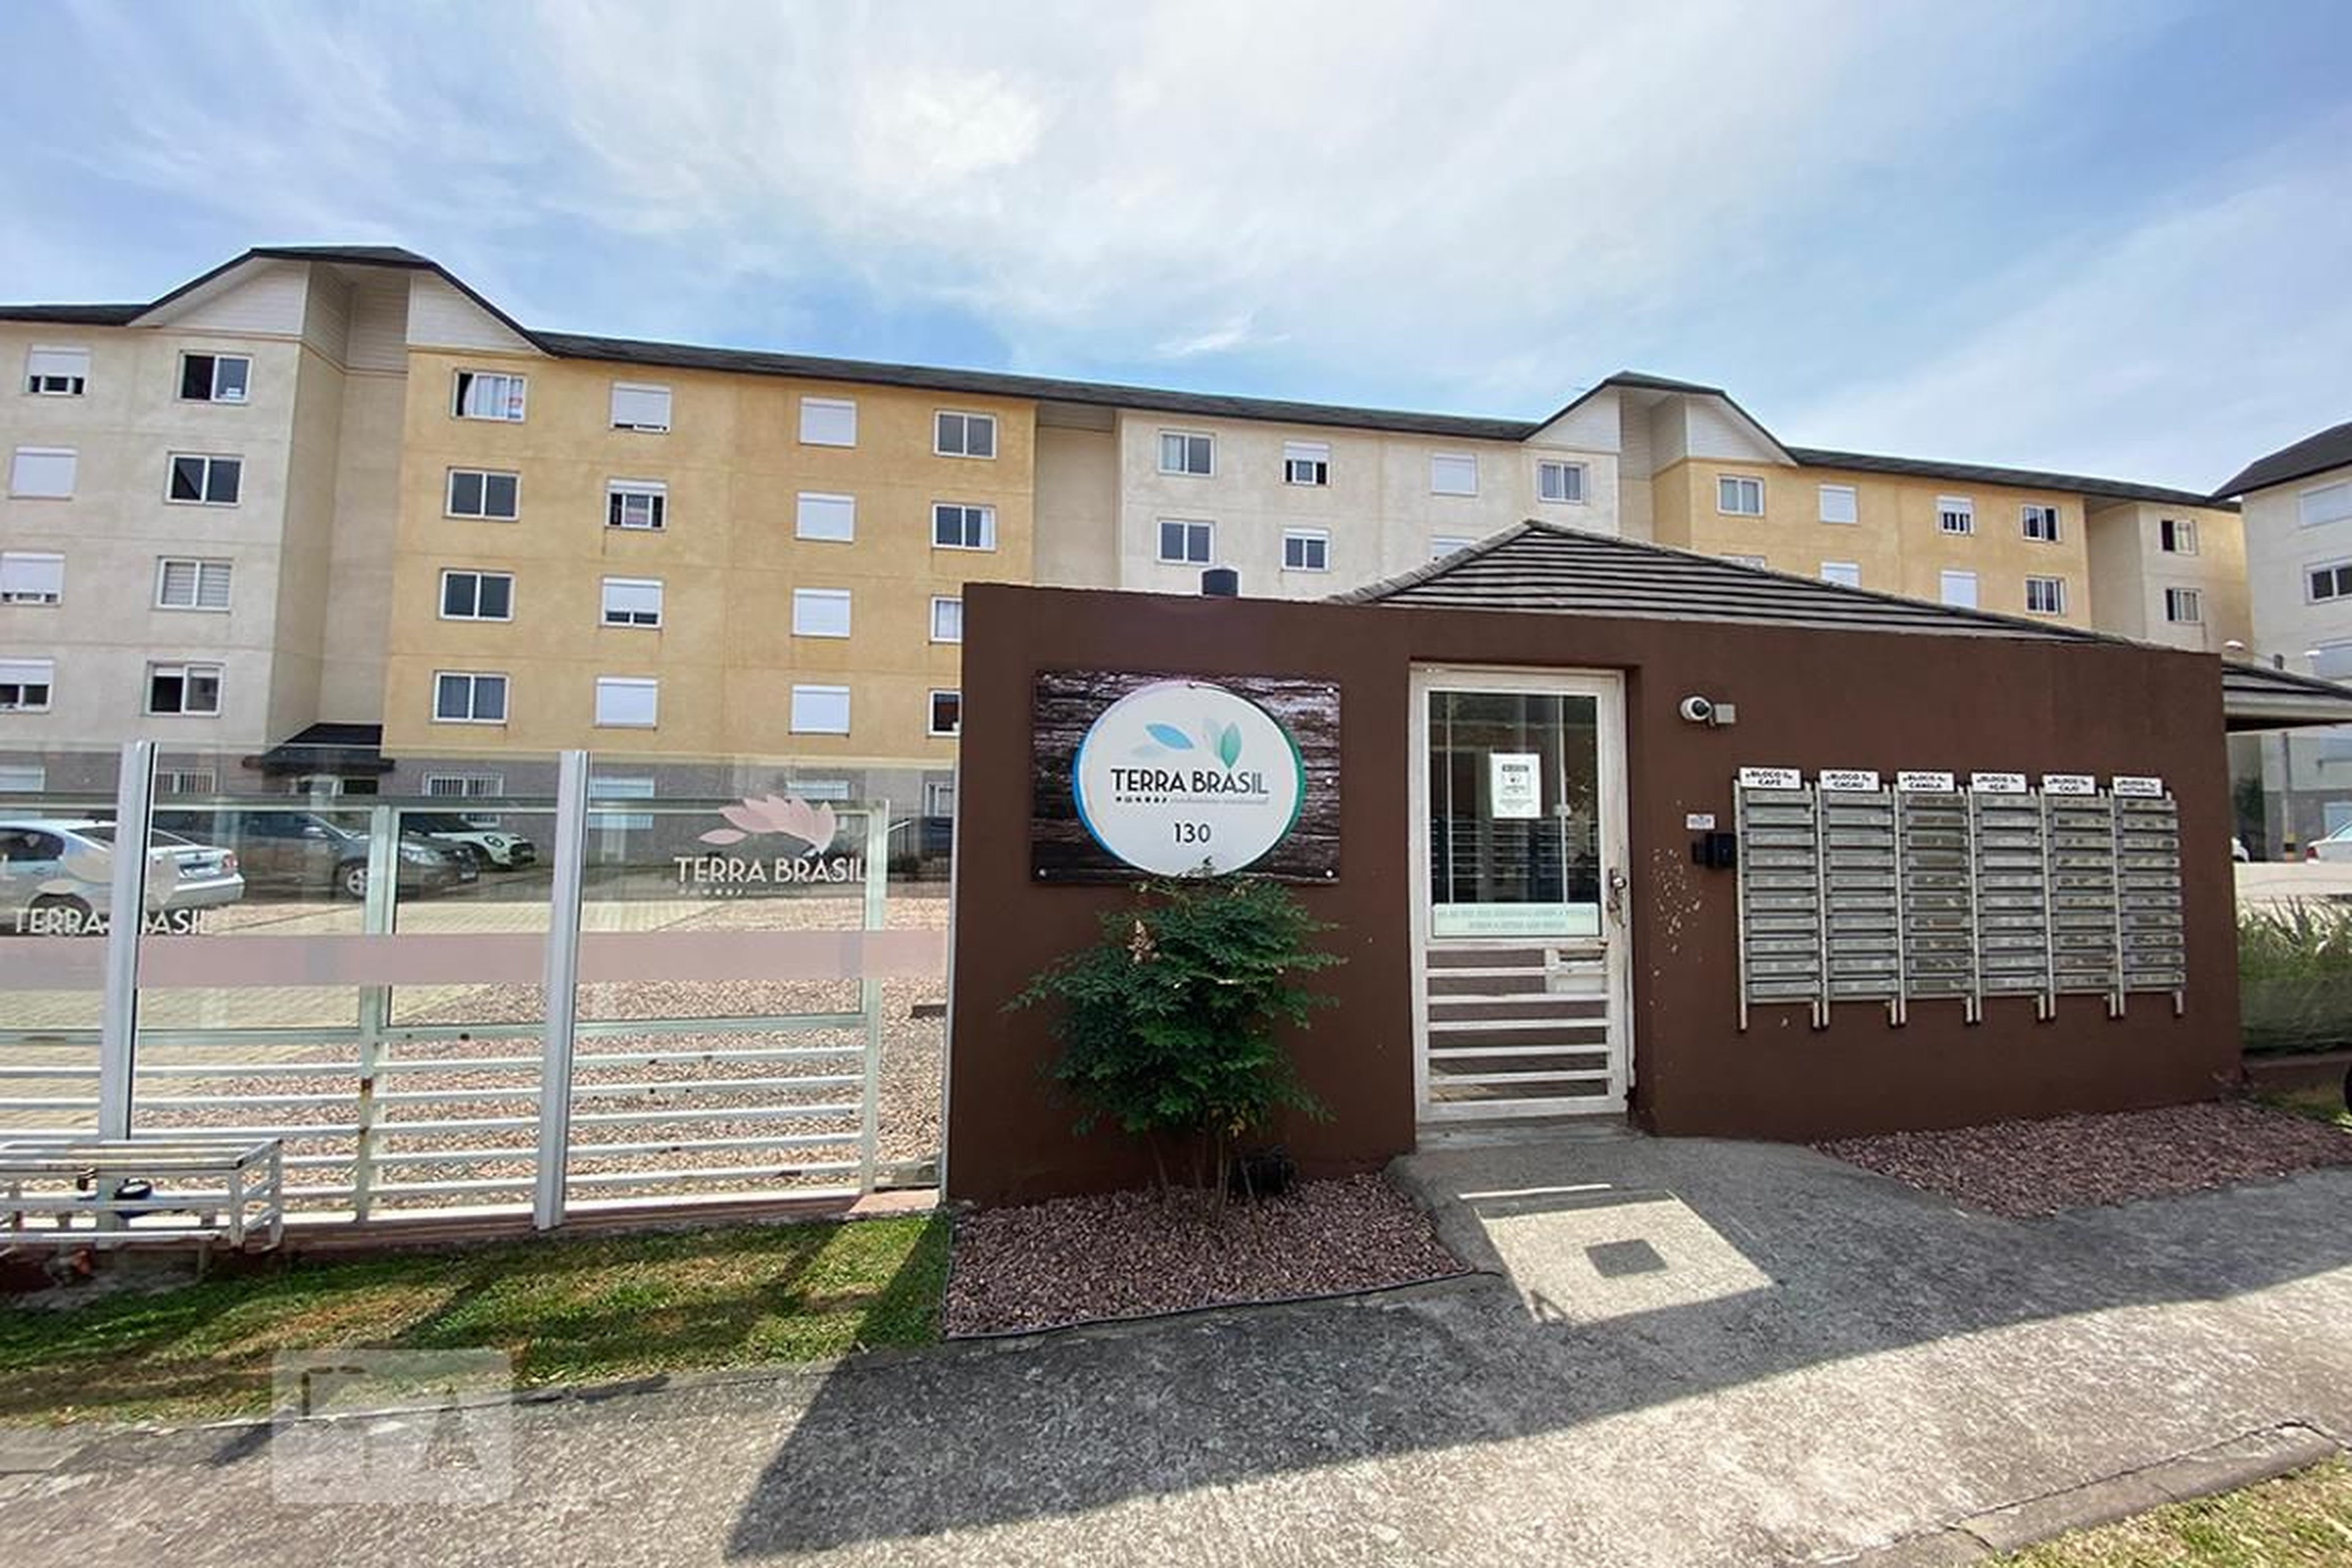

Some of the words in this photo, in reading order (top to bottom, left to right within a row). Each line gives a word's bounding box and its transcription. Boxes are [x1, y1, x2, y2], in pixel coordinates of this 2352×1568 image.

[1110, 769, 1187, 793] TERRA
[1192, 771, 1269, 794] BRASIL
[1175, 823, 1212, 843] 130
[674, 857, 767, 883] TERRA
[774, 857, 867, 883] BRASIL
[14, 908, 105, 935] TERRA
